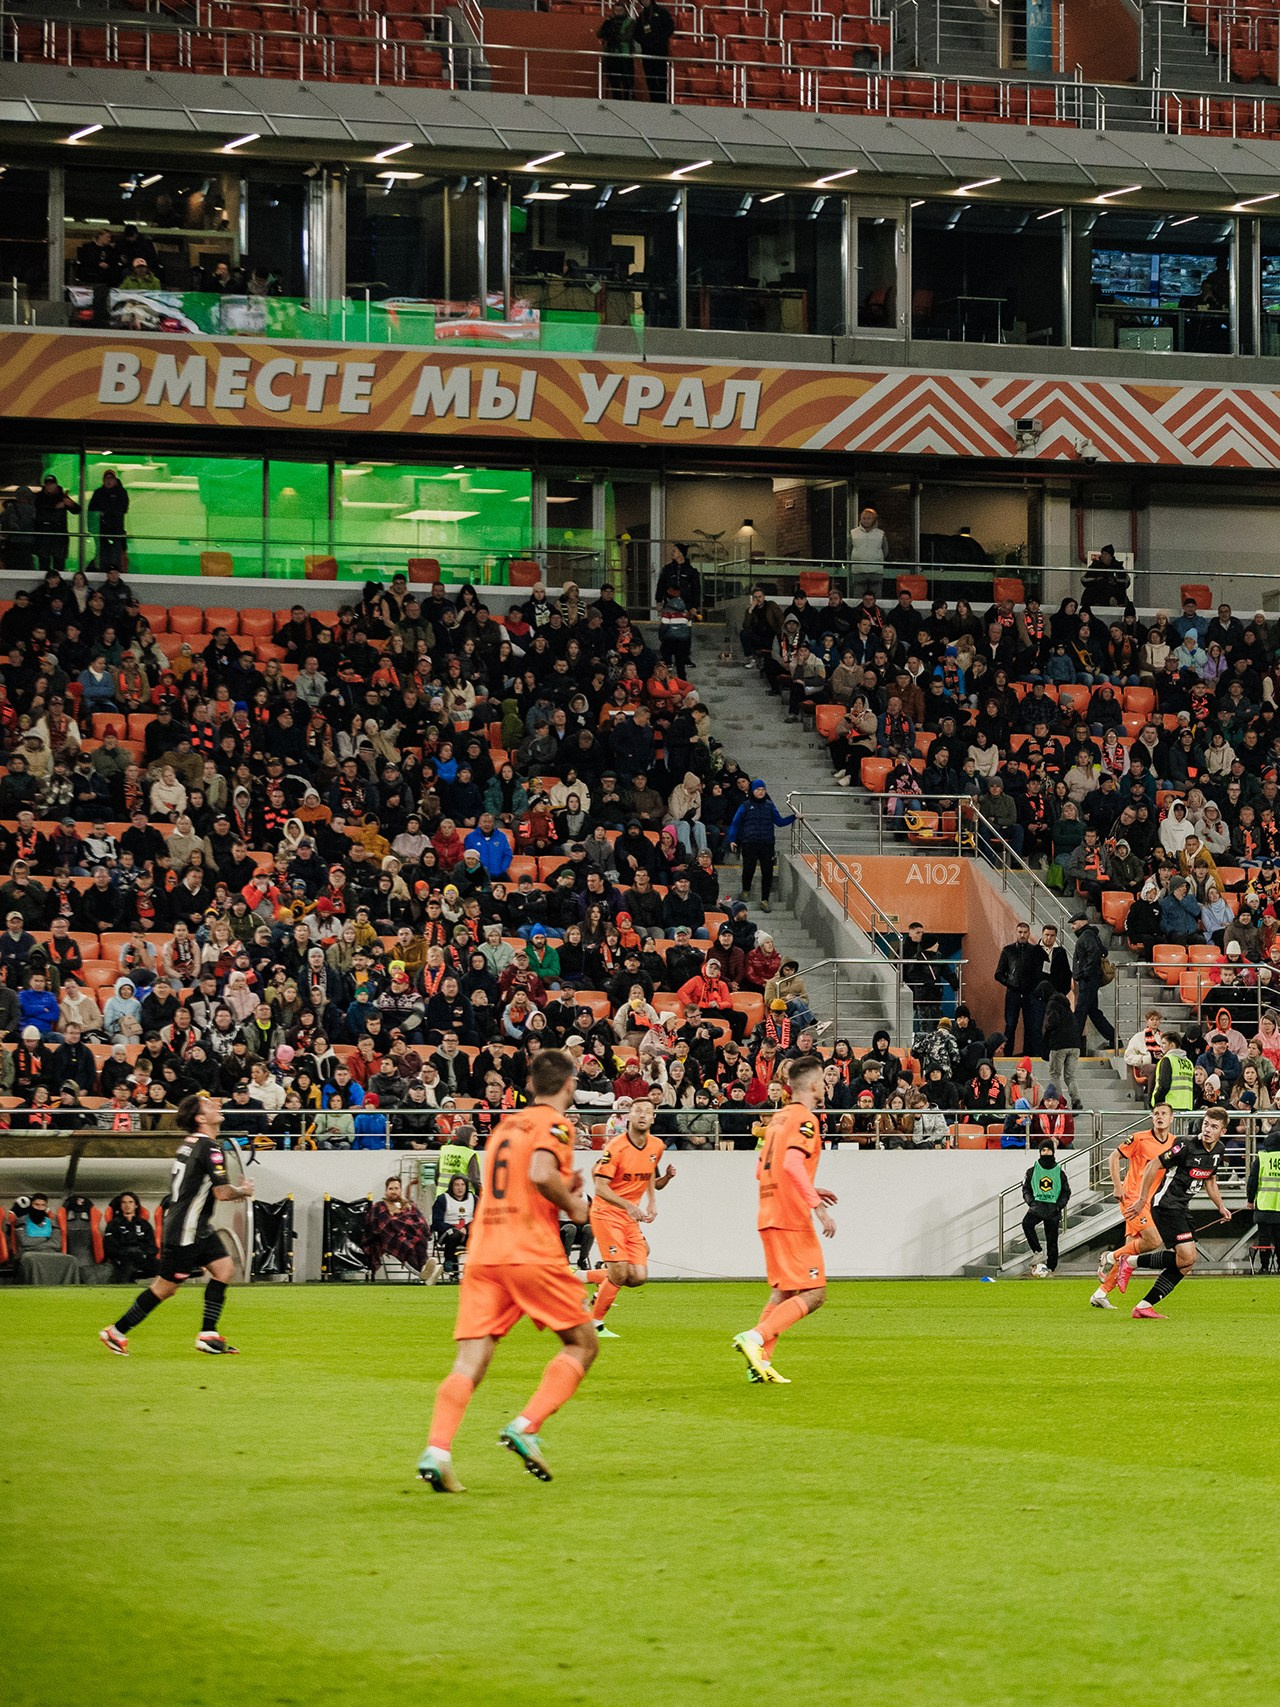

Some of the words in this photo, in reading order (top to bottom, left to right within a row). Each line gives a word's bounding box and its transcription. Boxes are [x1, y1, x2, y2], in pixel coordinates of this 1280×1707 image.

[98, 352, 377, 415] ВМЕСТЕ
[411, 366, 538, 420] МЫ
[580, 373, 763, 430] УРАЛ
[905, 863, 960, 886] A102
[492, 1139, 510, 1199] 6
